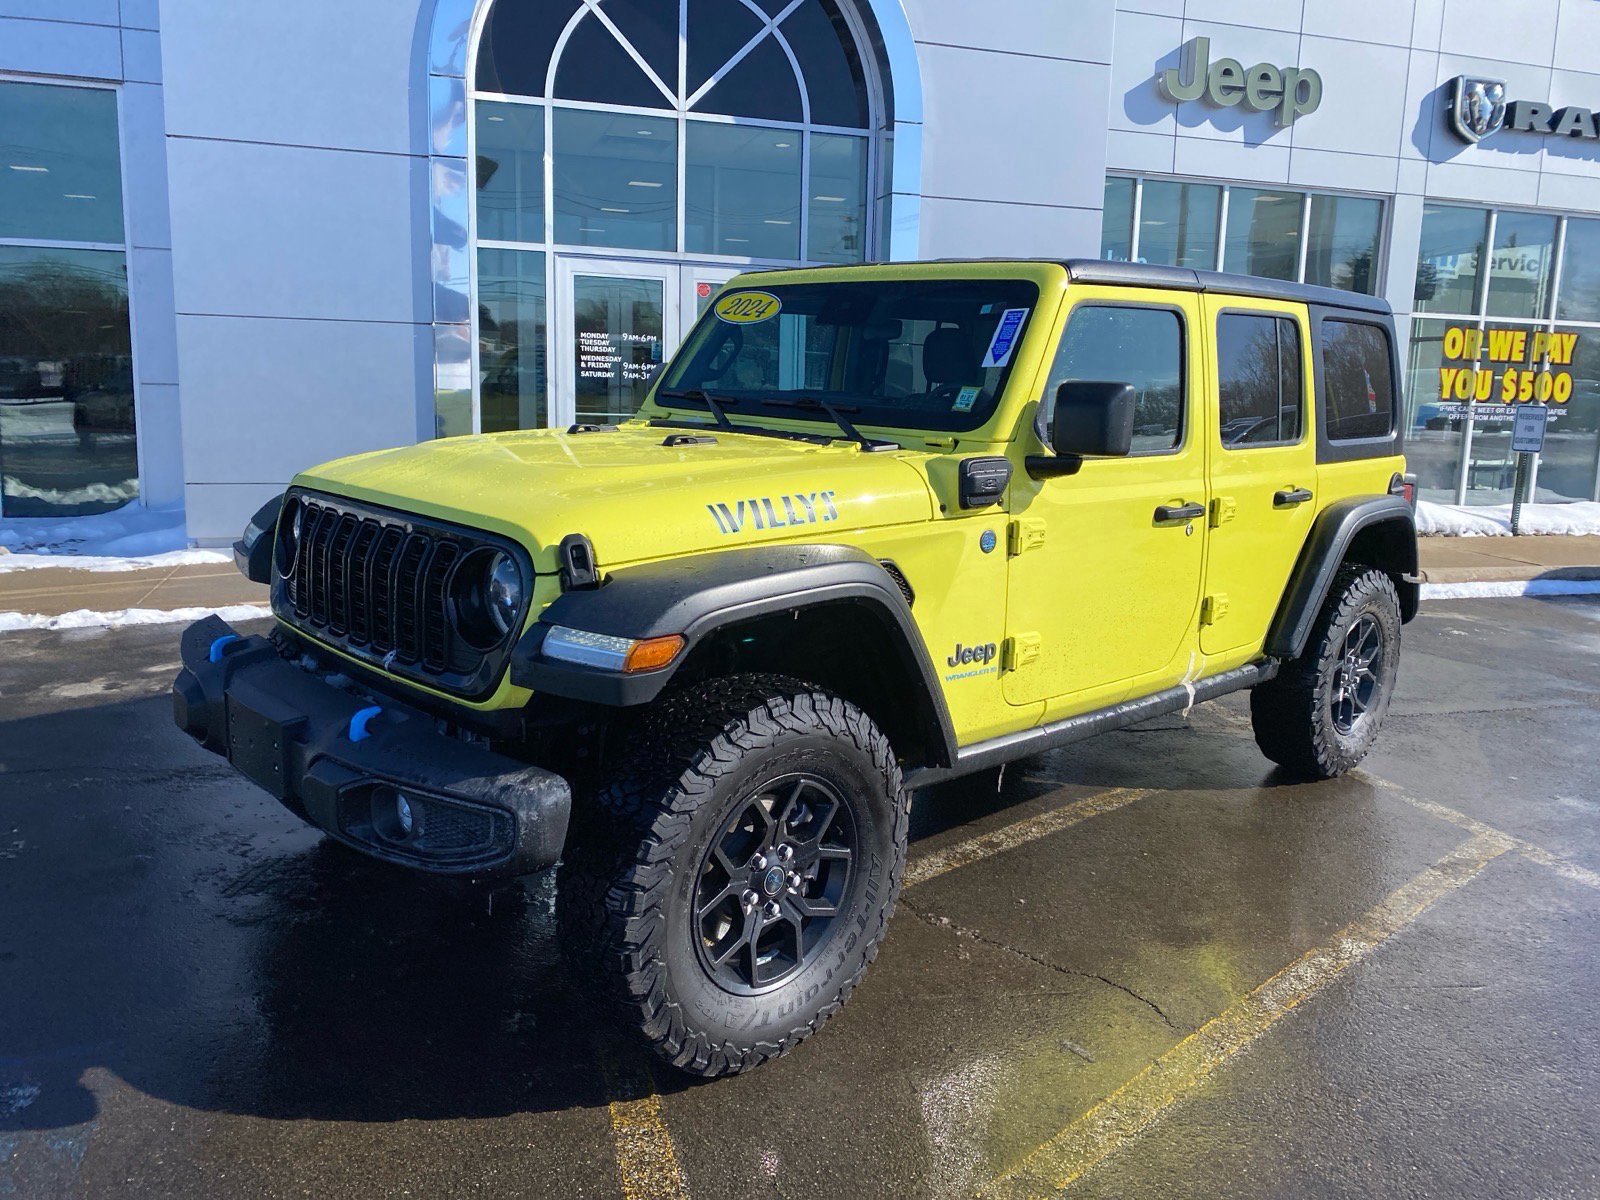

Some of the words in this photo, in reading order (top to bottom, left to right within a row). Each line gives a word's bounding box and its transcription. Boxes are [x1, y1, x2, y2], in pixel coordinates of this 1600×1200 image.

[1160, 36, 1323, 126] Jeep
[1504, 100, 1600, 138] RA
[721, 297, 774, 318] 2024
[1443, 327, 1484, 361] OR
[1488, 329, 1527, 363] WE
[1532, 331, 1578, 365] PAY
[1440, 367, 1494, 401] YOU
[1501, 367, 1574, 404] $500
[705, 490, 838, 534] WILLYS
[947, 643, 997, 668] Jeep
